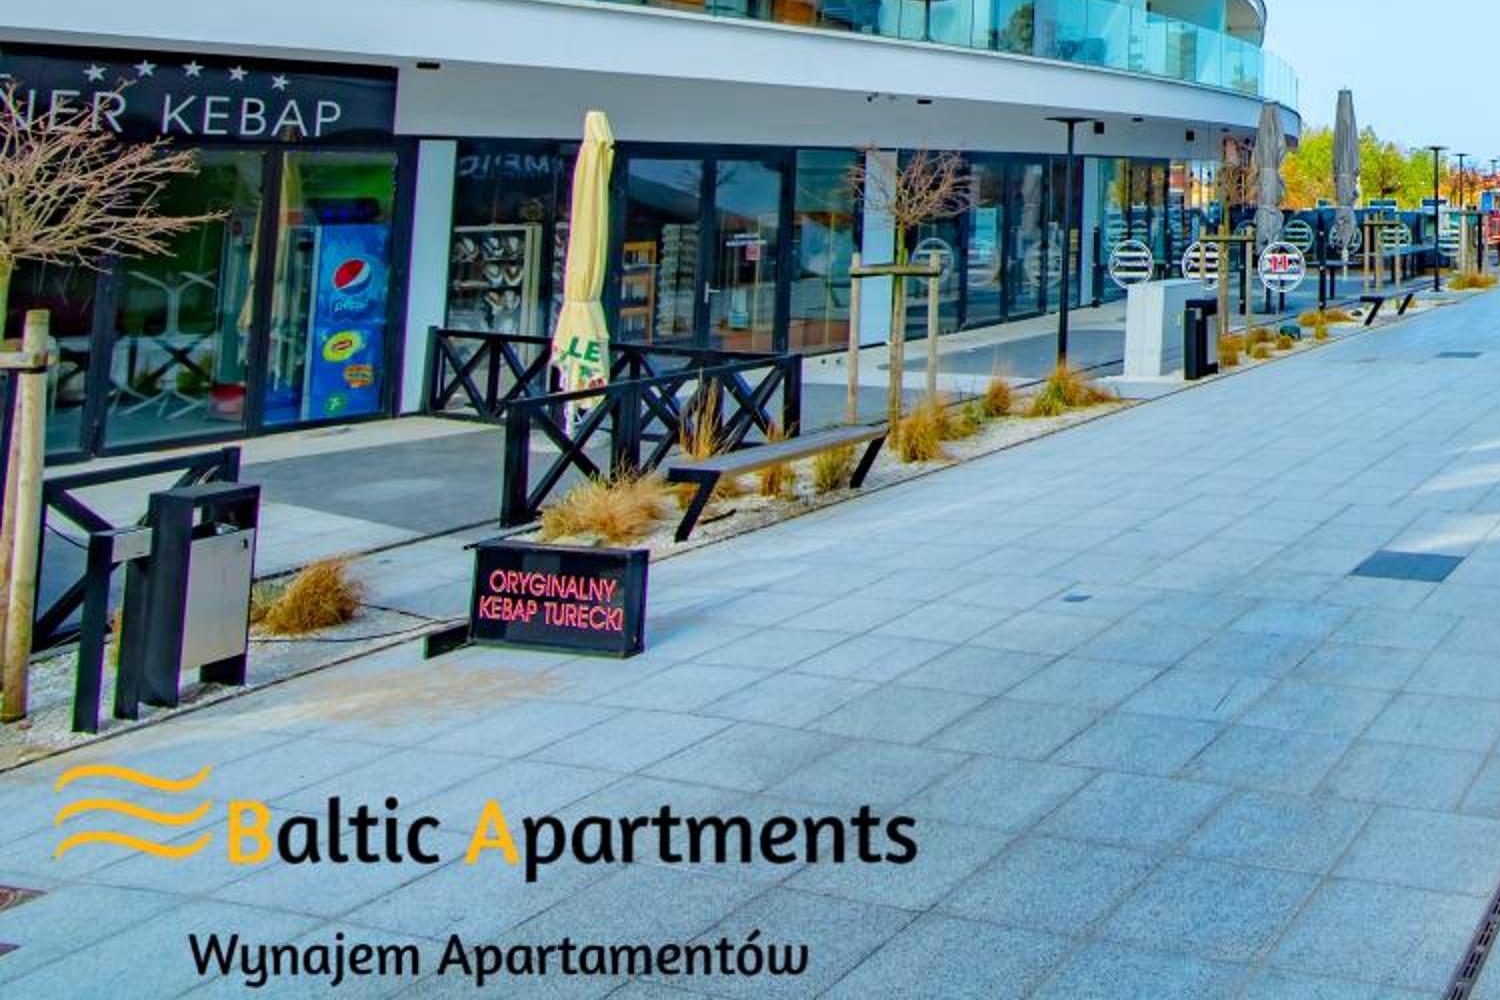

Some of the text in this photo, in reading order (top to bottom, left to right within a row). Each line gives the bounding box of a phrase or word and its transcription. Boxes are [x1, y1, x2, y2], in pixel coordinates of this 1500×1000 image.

[161, 93, 342, 138] KEBAP
[489, 567, 617, 603] ORYGINALNY
[478, 594, 625, 633] KEBAP TURECKI
